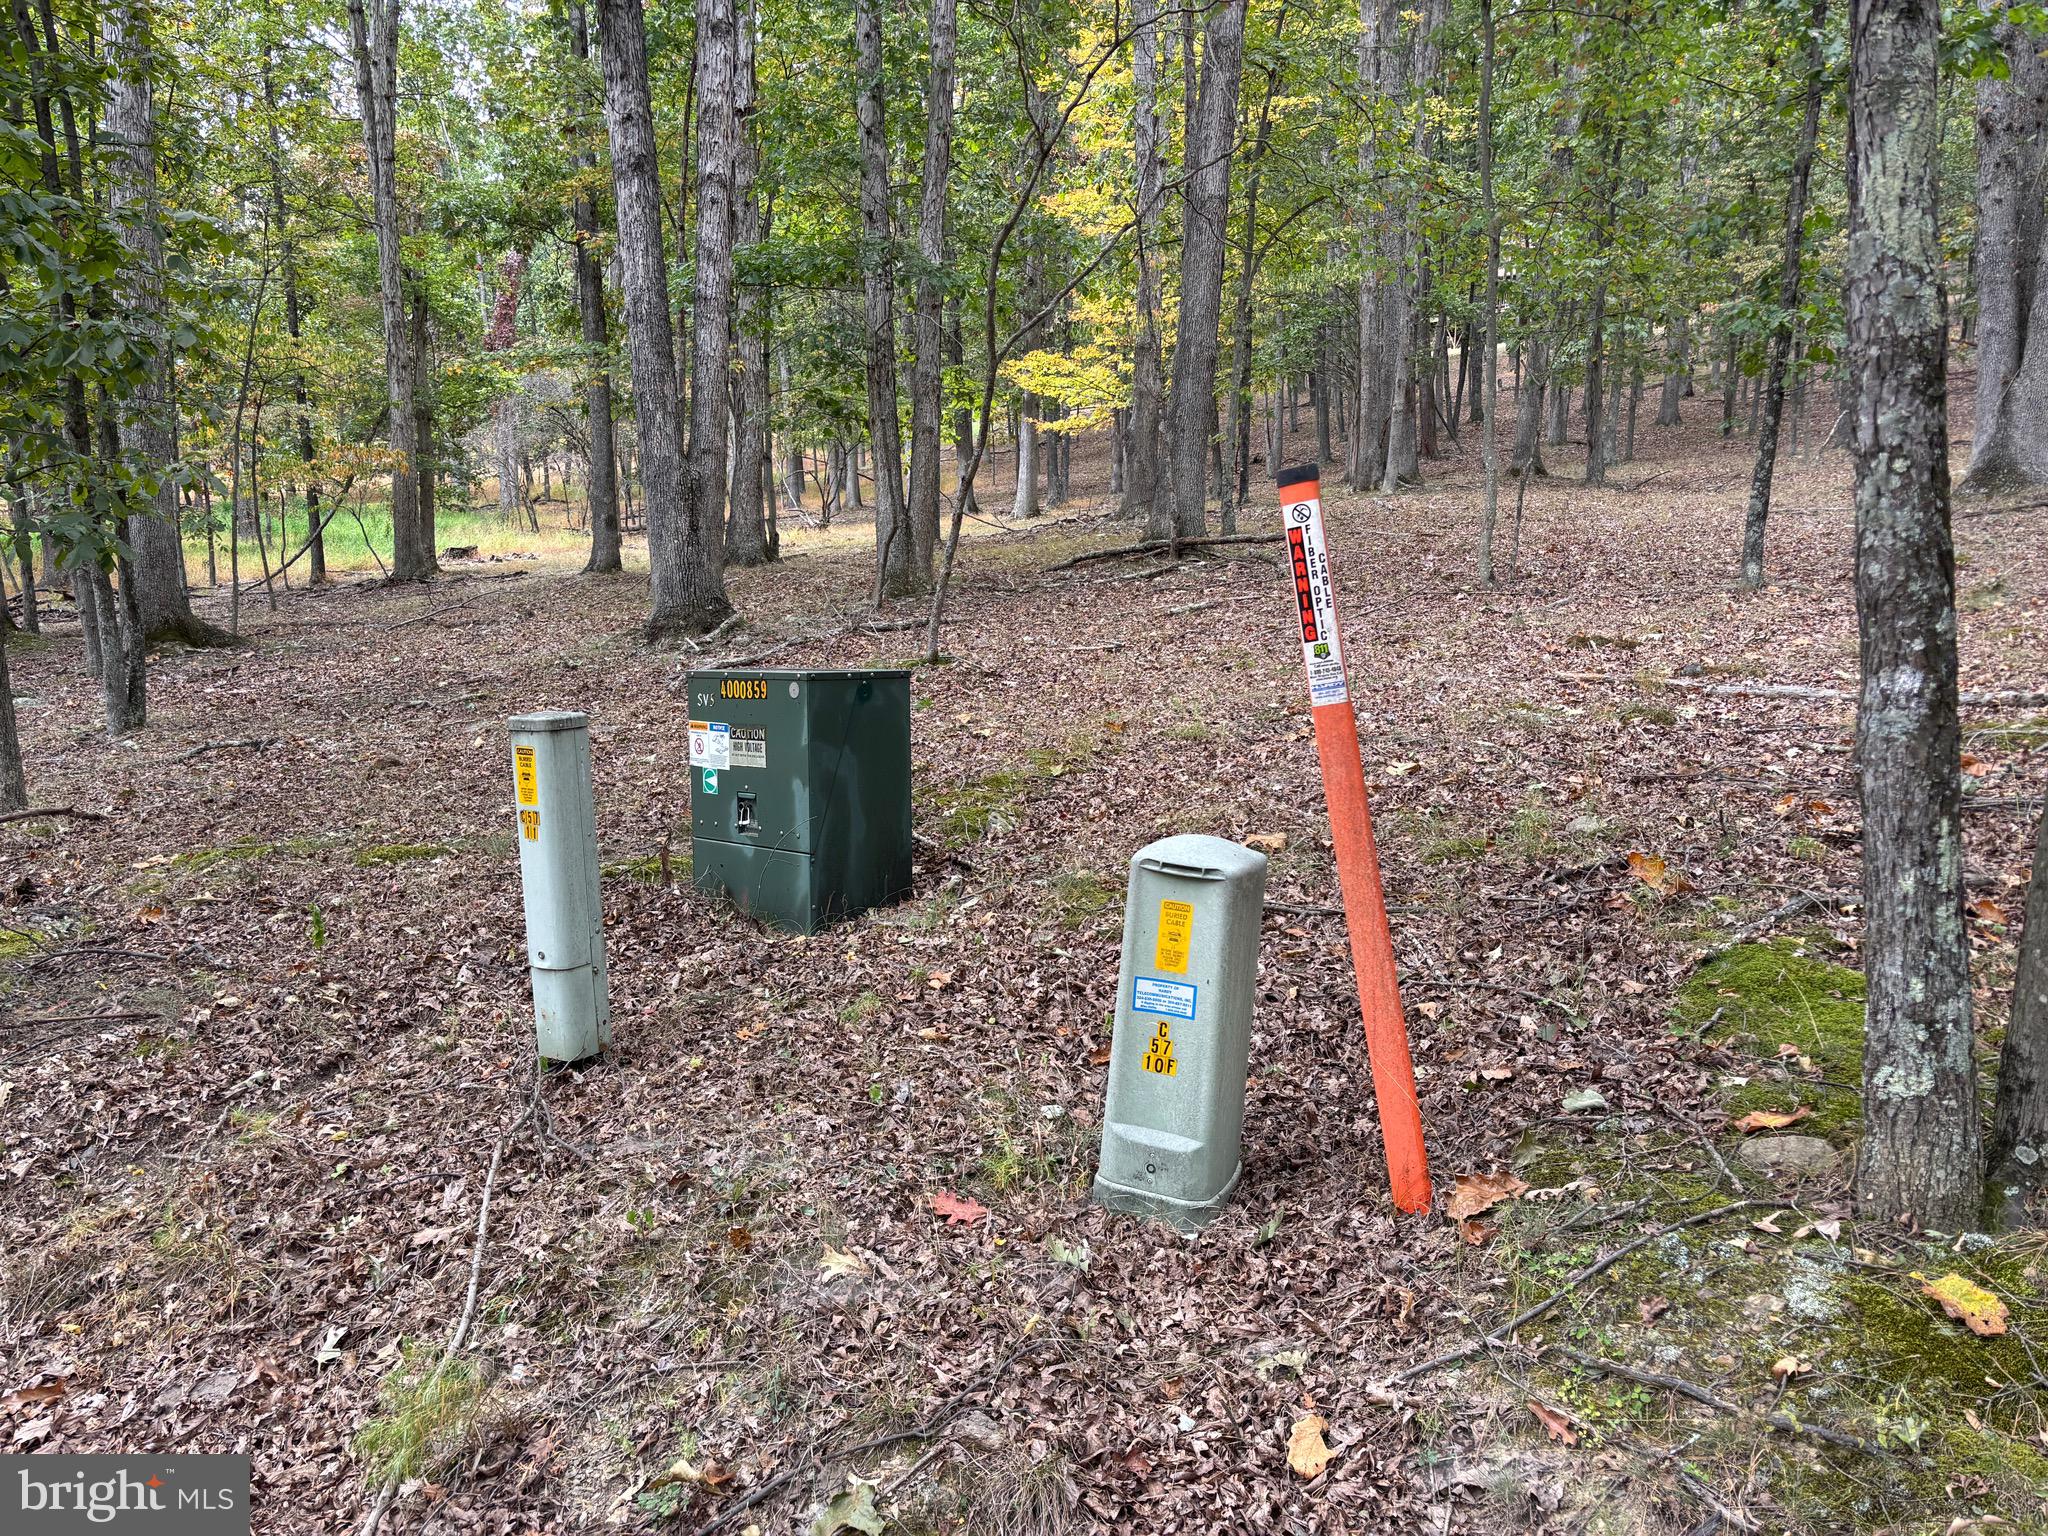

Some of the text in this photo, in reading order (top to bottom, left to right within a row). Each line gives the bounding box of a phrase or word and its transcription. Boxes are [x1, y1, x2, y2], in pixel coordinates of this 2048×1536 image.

[1288, 528, 1317, 641] WARNING
[1305, 524, 1328, 640] FIBER OPTIC
[1318, 553, 1332, 608] CABLE
[1314, 644, 1329, 655] 811
[720, 680, 767, 699] 4000859
[730, 727, 765, 740] CAUTION
[1164, 902, 1190, 912] CAUTION
[1165, 911, 1188, 920] BURIED
[1166, 919, 1185, 927] CABLE
[1159, 1022, 1168, 1037] C
[1151, 1038, 1171, 1055] 57
[1146, 1055, 1175, 1074] 10F
